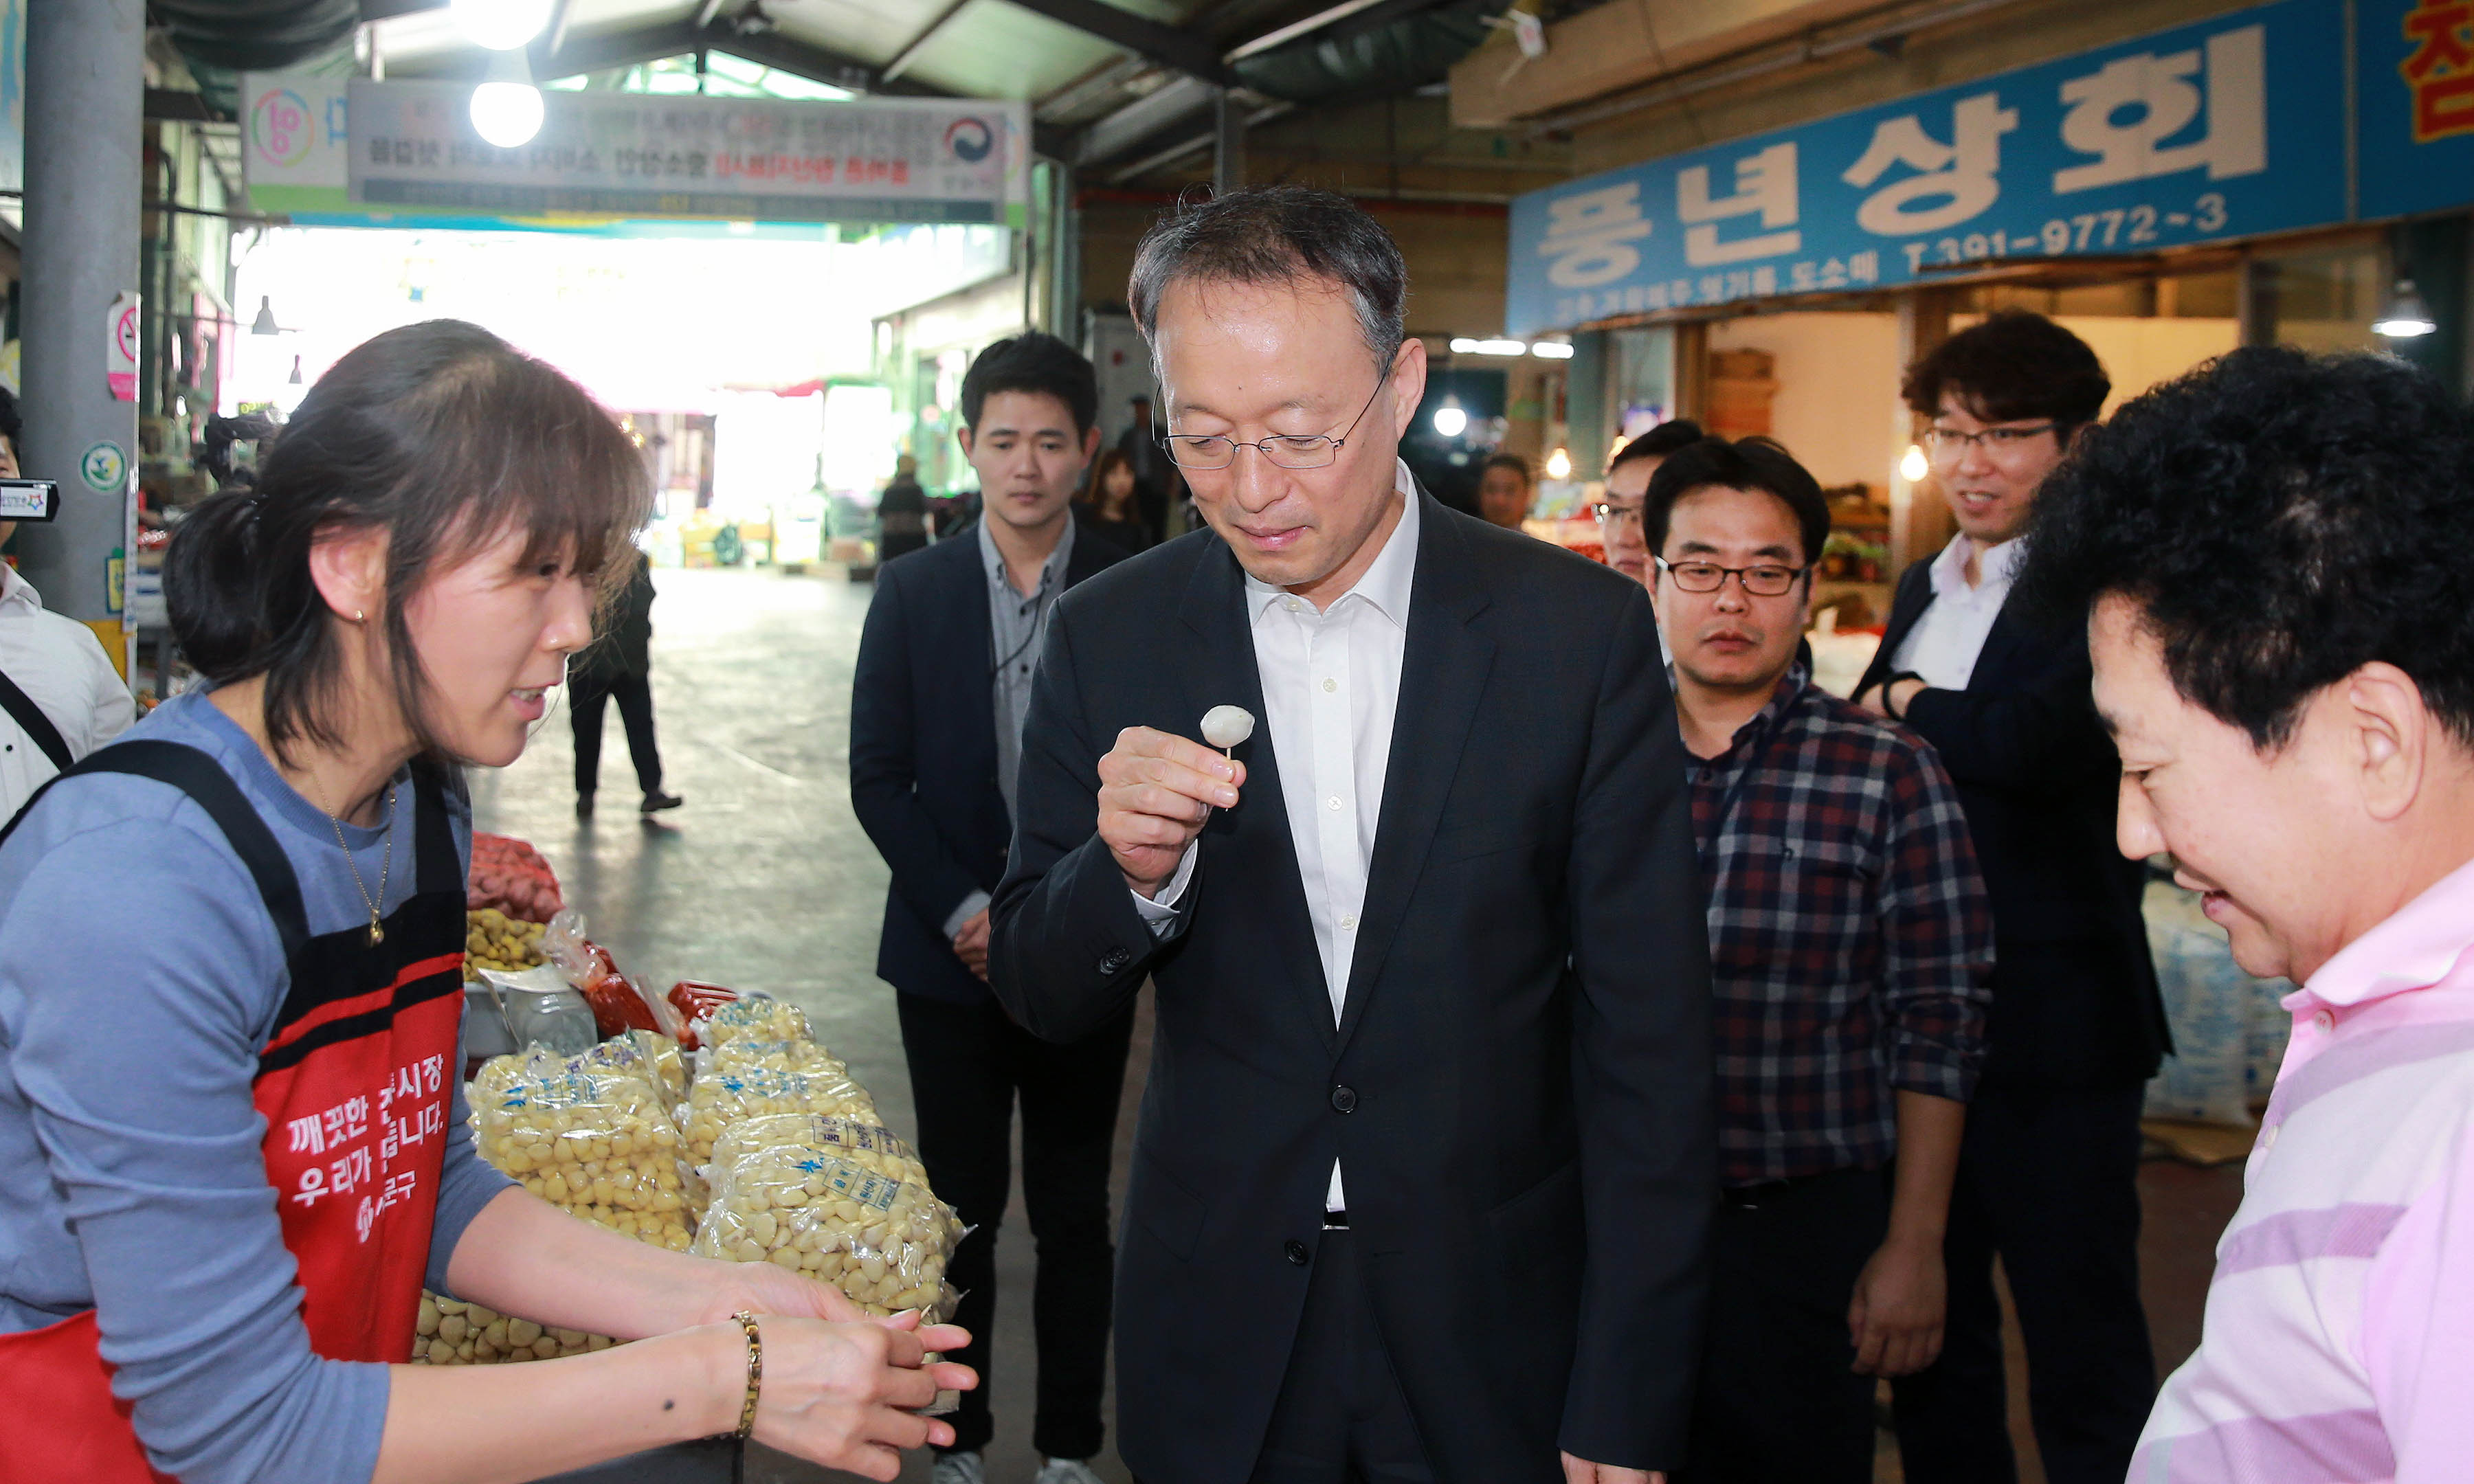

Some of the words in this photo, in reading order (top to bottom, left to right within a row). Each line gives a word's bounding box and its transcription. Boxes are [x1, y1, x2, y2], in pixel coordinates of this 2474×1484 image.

[287, 1094, 369, 1155] 깨끗한
[379, 1053, 444, 1125] 시장
[292, 1145, 372, 1207] 우리가
[380, 1101, 443, 1174] 니다.
